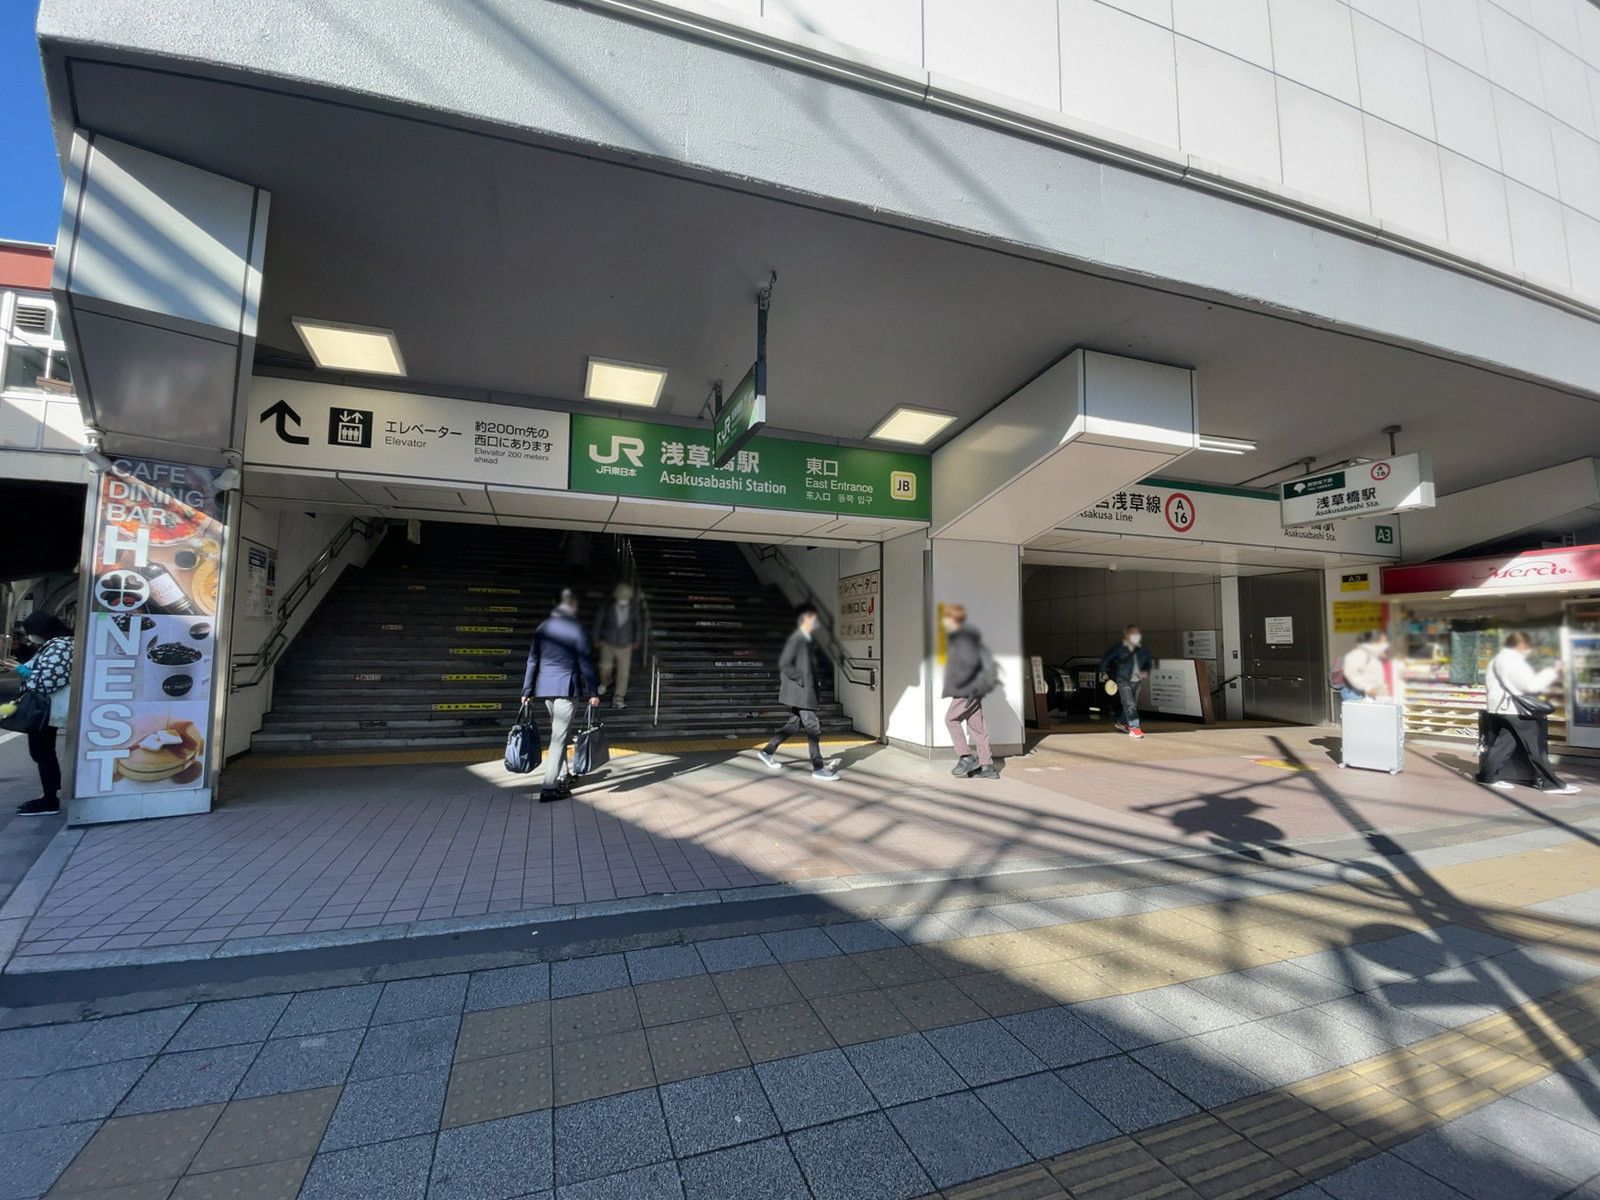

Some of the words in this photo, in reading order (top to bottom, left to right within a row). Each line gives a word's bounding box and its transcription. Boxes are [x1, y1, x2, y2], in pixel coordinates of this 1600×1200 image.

[385, 420, 462, 439] エレベーター
[475, 420, 549, 439] 約200m先の
[385, 436, 427, 449] Elevator
[474, 434, 554, 453] 西口にあります
[474, 448, 506, 458] Elevator
[507, 450, 522, 460] 200
[524, 453, 550, 462] meters
[589, 435, 645, 468] JR
[474, 456, 498, 465] ahead
[806, 457, 839, 477] 東口
[112, 459, 186, 484] CAFE
[596, 465, 637, 477] JR東日本
[660, 470, 743, 491] Asakusabashi
[746, 478, 787, 495] Station
[805, 477, 828, 489] East
[830, 480, 874, 494] Entrance
[896, 480, 910, 492] JB
[109, 481, 205, 508] DINING
[806, 491, 831, 502] 东入口
[1316, 487, 1376, 509] 浅草橋駅
[1176, 499, 1185, 510] A
[1315, 503, 1364, 516] Asakusabashi
[107, 502, 167, 526] BAR
[1115, 511, 1134, 522] Line
[1174, 511, 1188, 524] 16
[1284, 528, 1325, 541] Asakusabashi
[1377, 528, 1392, 542] A3
